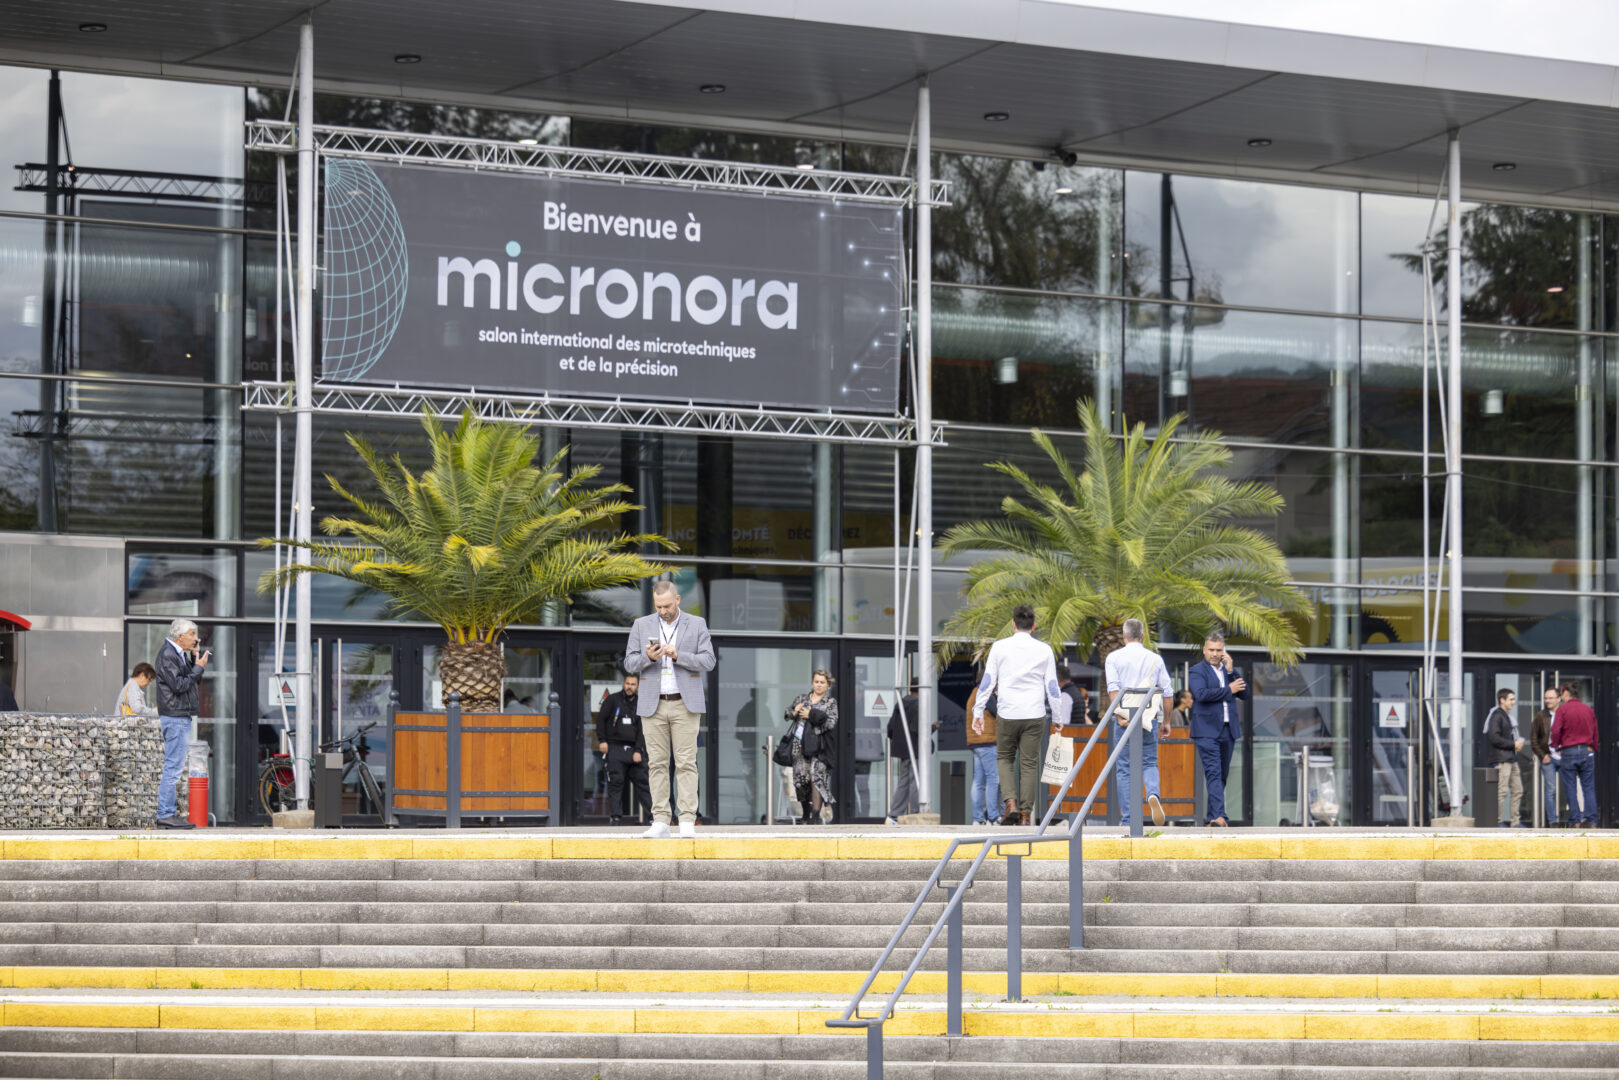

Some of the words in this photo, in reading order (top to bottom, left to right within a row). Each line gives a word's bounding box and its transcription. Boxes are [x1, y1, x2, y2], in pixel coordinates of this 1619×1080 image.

[543, 200, 678, 241] Bienvenue
[684, 212, 702, 243] à
[437, 240, 798, 331] micronora
[478, 325, 518, 344] salon
[520, 327, 614, 351] international
[615, 334, 641, 352] des
[643, 336, 757, 361] microtechniques
[559, 356, 574, 371] et
[577, 356, 597, 372] de
[599, 355, 613, 373] la
[615, 357, 679, 379] précision
